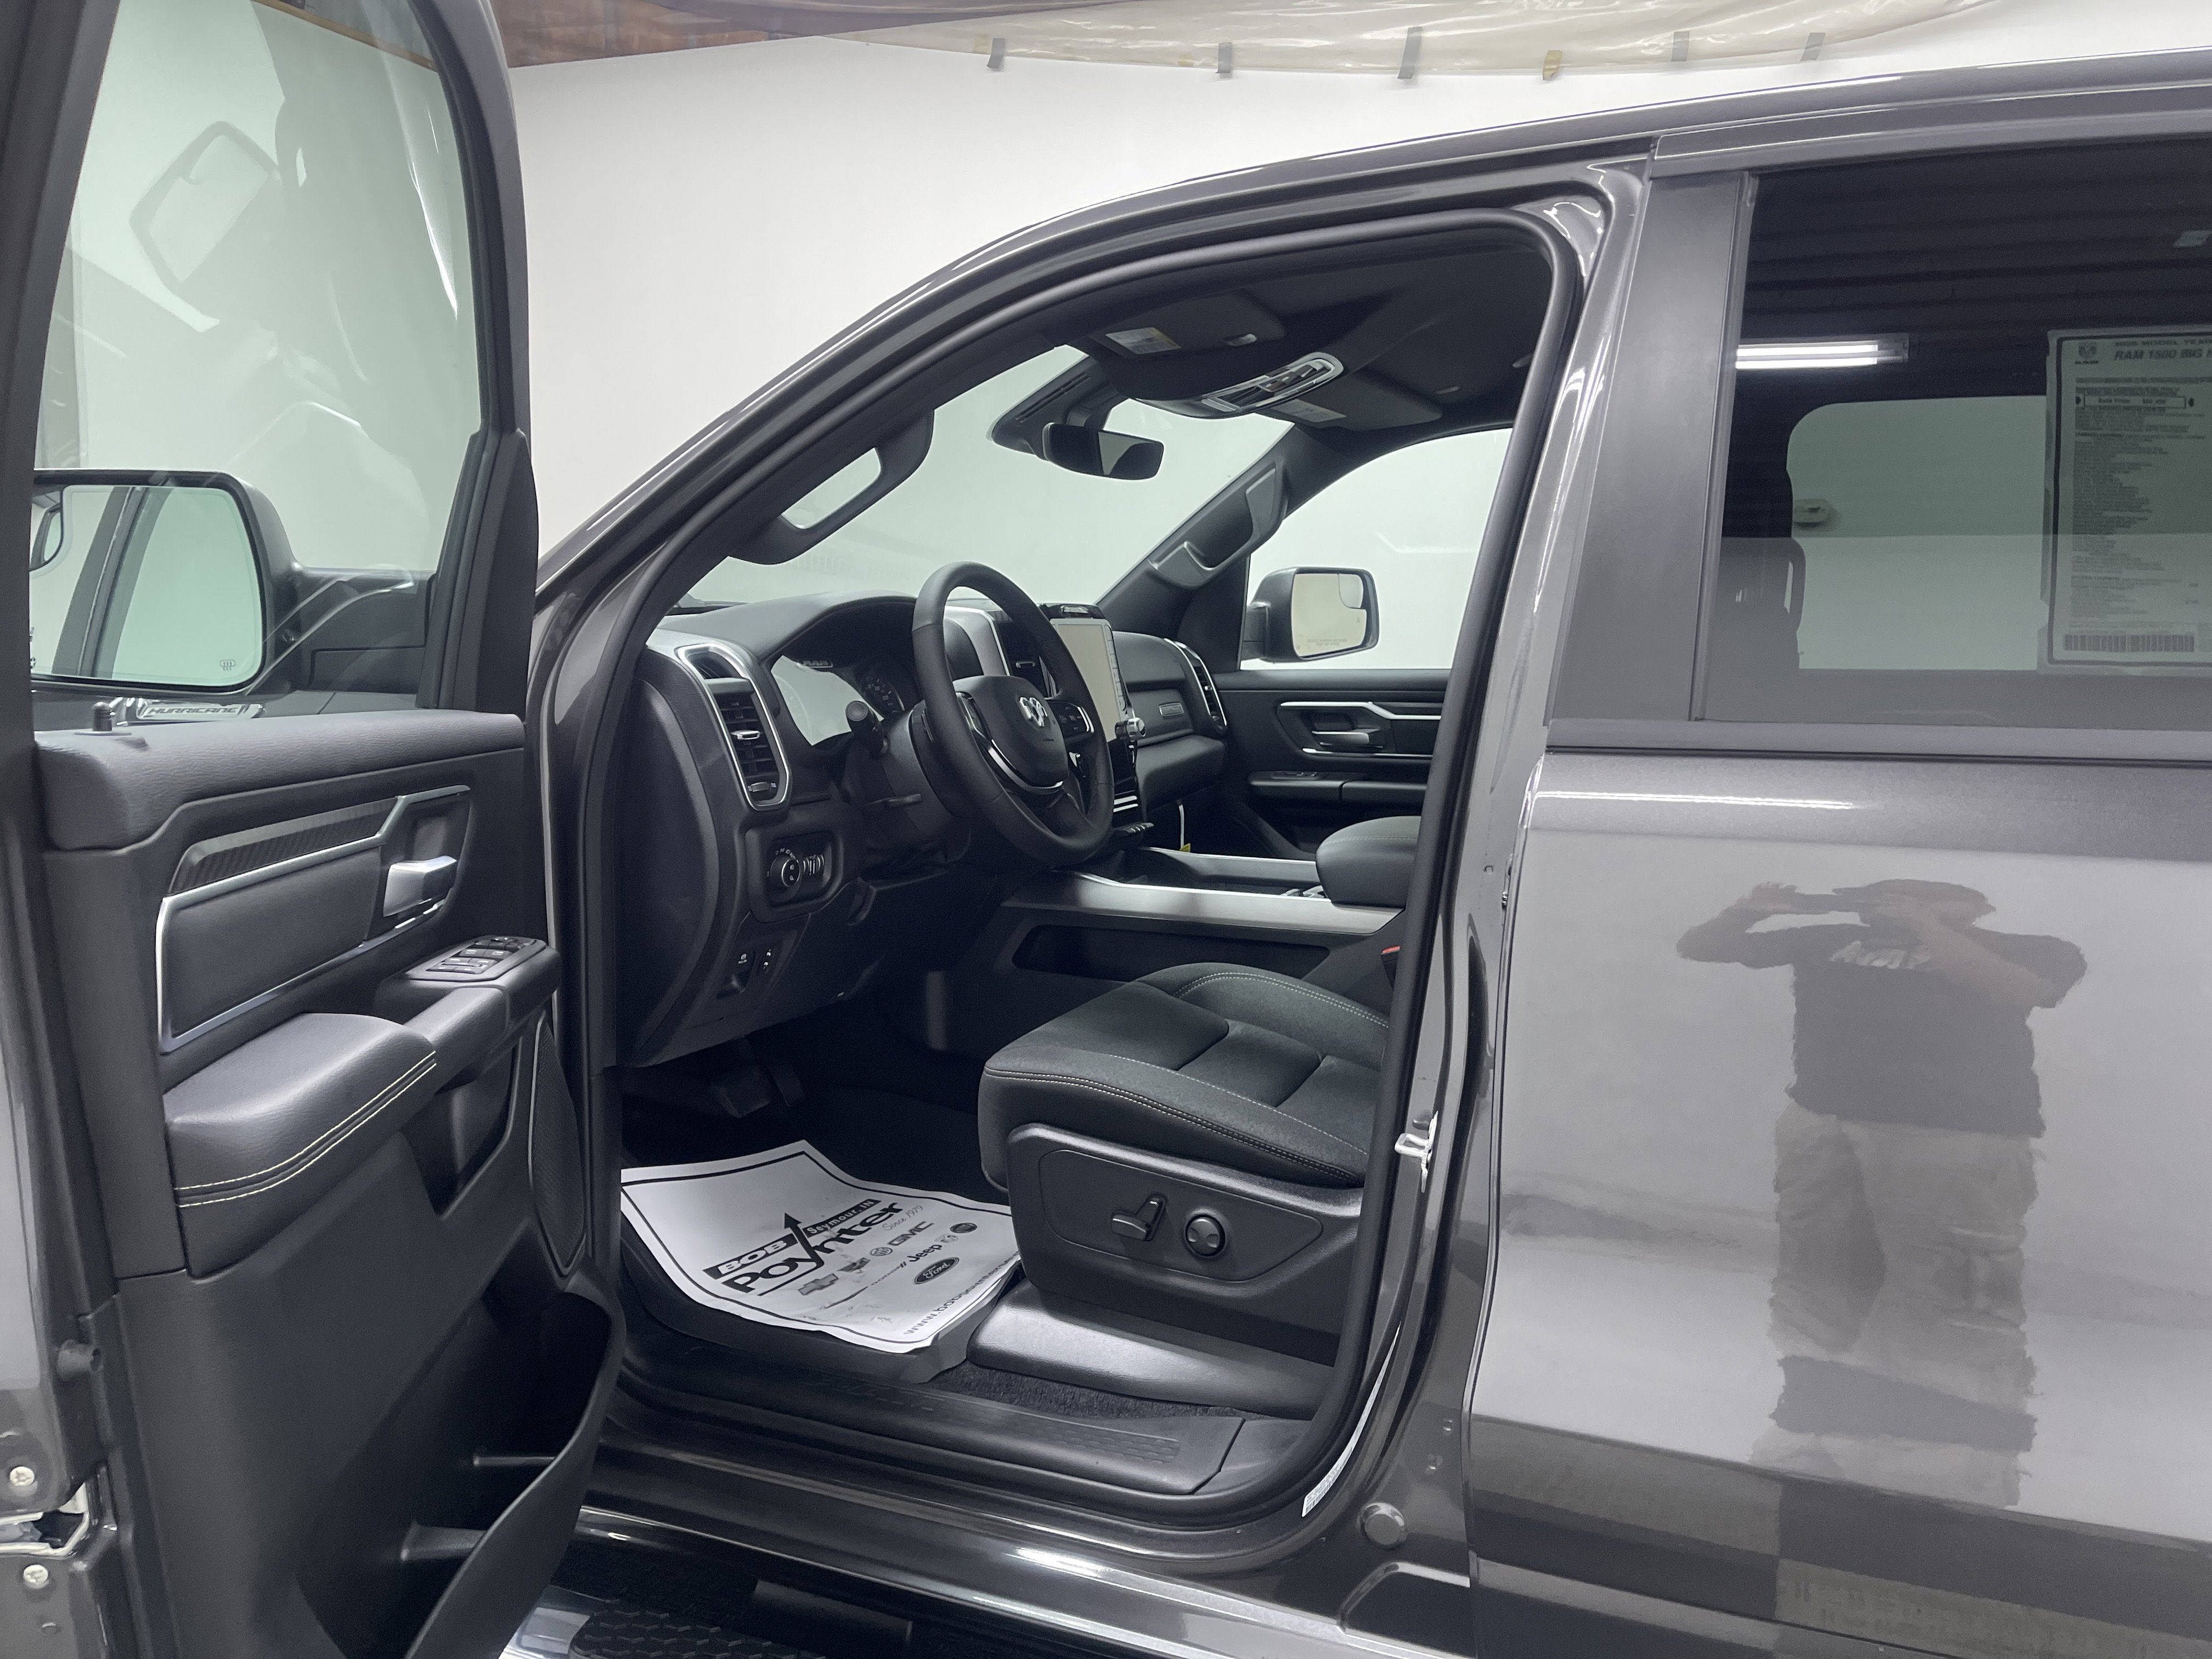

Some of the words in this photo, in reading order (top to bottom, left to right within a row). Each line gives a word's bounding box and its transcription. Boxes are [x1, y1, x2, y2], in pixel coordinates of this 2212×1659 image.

[2114, 350, 2144, 360] RAM
[882, 1216, 906, 1231] Since
[907, 1205, 923, 1218] 1979
[887, 1221, 935, 1246] GMC
[718, 1240, 787, 1274] BOB
[907, 1244, 943, 1262] Jeep
[922, 1262, 951, 1278] Ford
